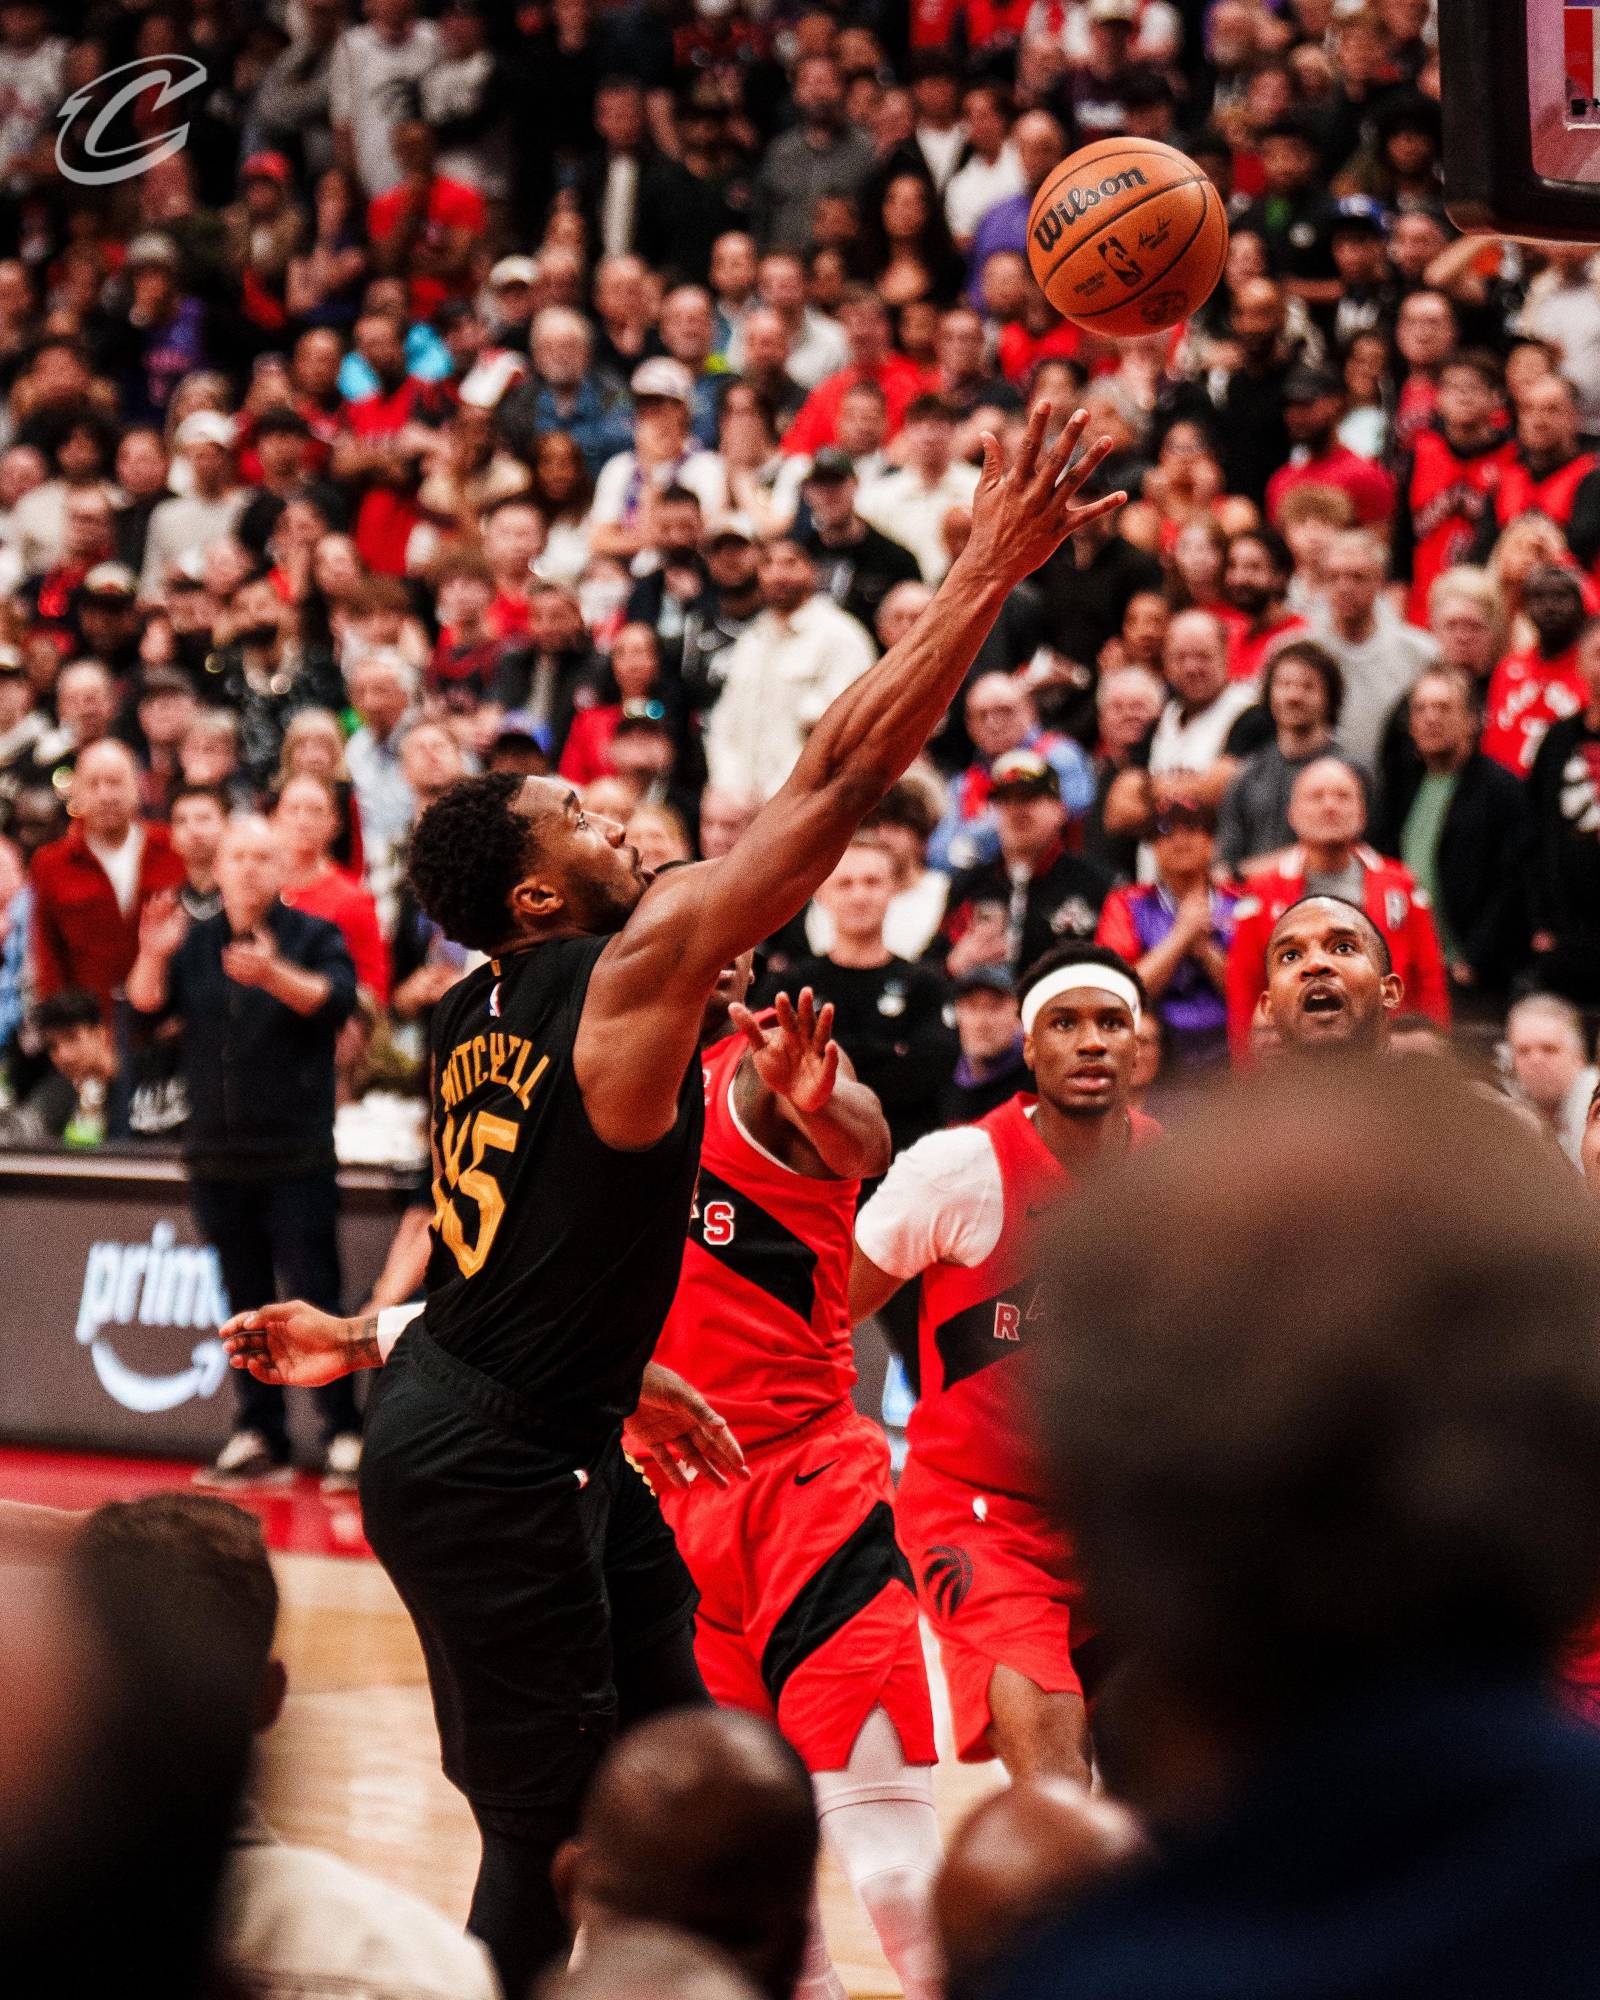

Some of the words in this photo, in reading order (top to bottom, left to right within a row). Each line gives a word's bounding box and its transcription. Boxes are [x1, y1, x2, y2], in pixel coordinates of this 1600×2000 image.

[1033, 166, 1149, 253] Wilson
[440, 1032, 550, 1113] MITCHELL
[690, 1192, 735, 1246] S
